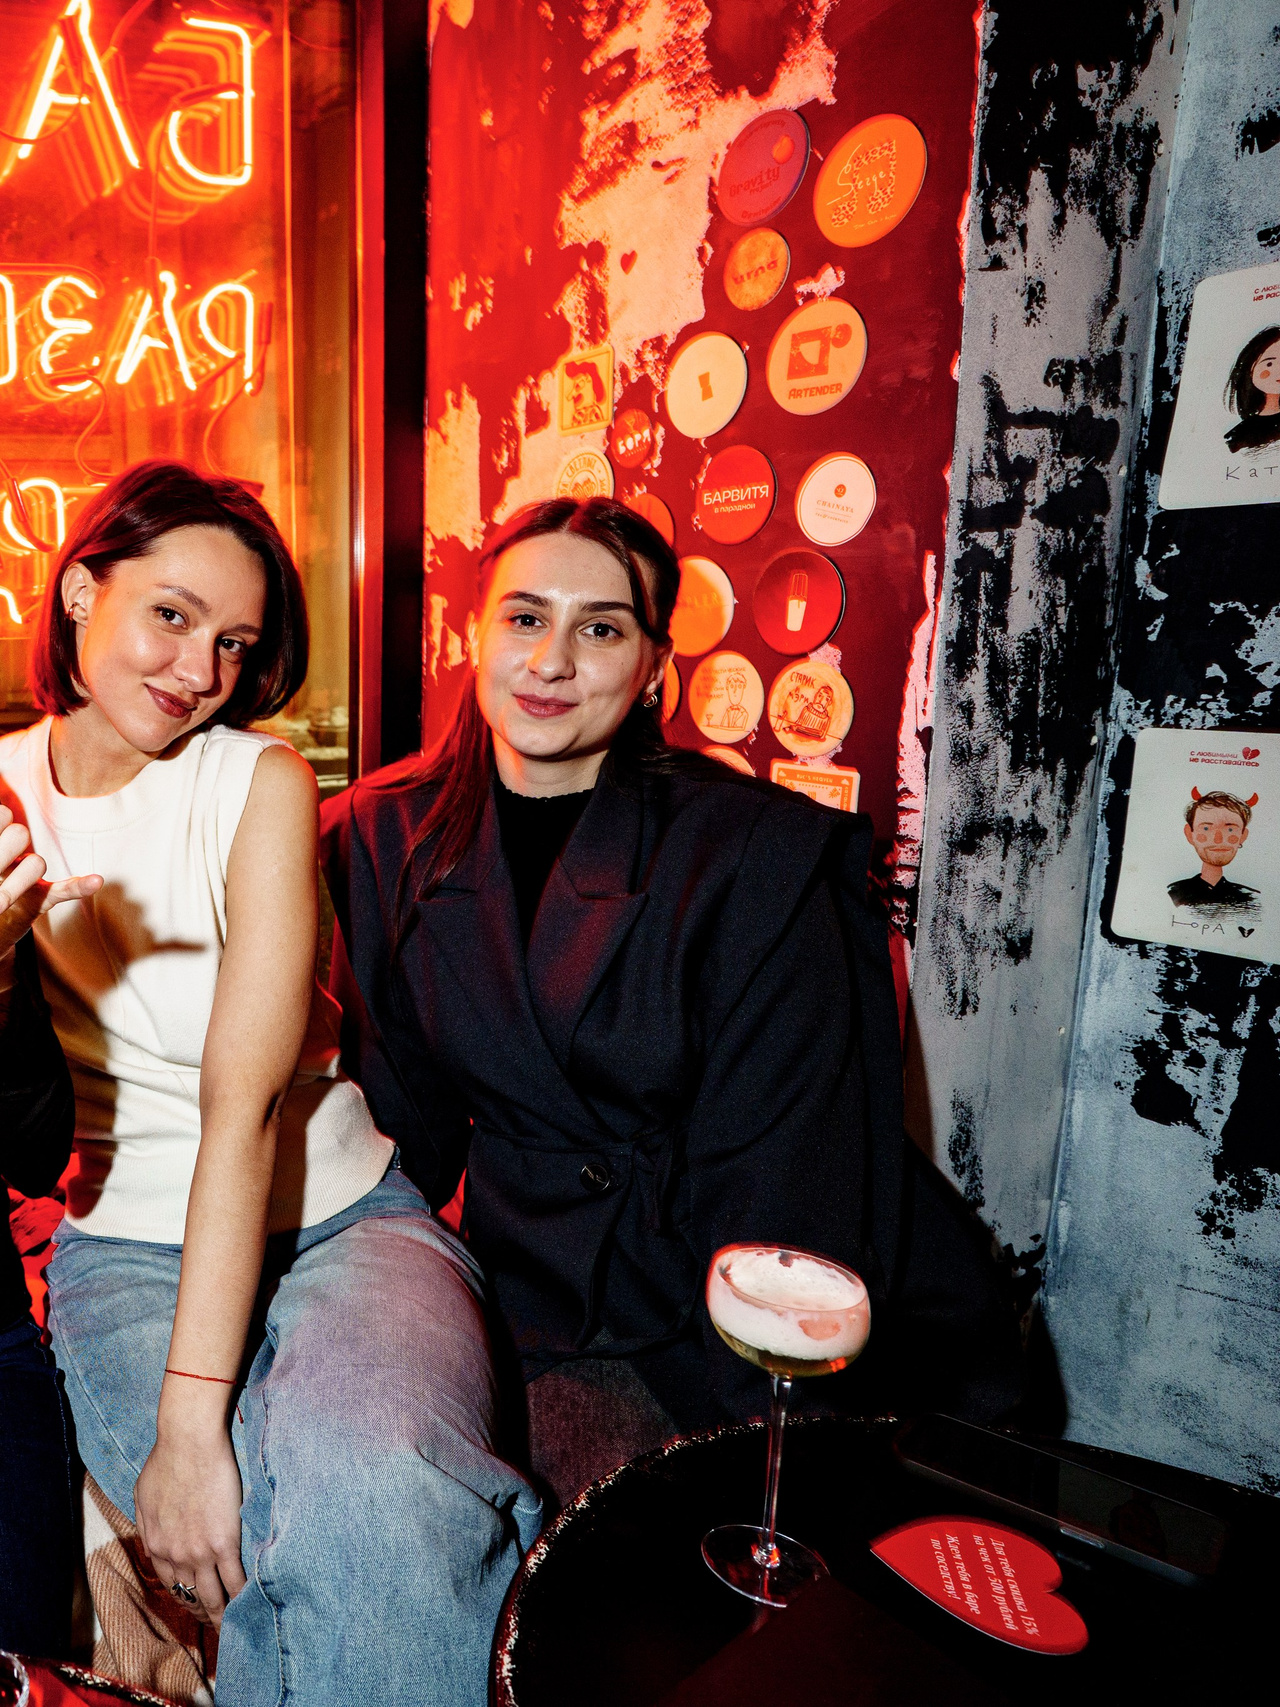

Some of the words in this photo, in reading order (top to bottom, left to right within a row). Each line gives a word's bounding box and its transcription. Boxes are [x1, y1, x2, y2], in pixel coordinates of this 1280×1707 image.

[729, 166, 780, 197] Gravity
[788, 382, 843, 400] ARTENDER
[619, 428, 652, 455] БОРЯ
[703, 484, 769, 505] БАРВИТЯ
[720, 503, 756, 514] парадной
[816, 499, 854, 514] CHAINAYA
[790, 671, 816, 689] СТАРИК
[930, 1538, 942, 1550] по
[973, 1534, 985, 1546] на
[978, 1547, 991, 1563] чек
[934, 1550, 961, 1601] соседству!
[983, 1564, 996, 1576] от
[955, 1561, 971, 1582] тебя
[964, 1591, 981, 1615] баре
[988, 1576, 1006, 1595] 500
[989, 1537, 1005, 1556] Для
[998, 1557, 1016, 1578] тебя
[1007, 1579, 1028, 1612] скидка
[1020, 1615, 1040, 1636] 15%
[991, 1594, 1019, 1631] рублей
